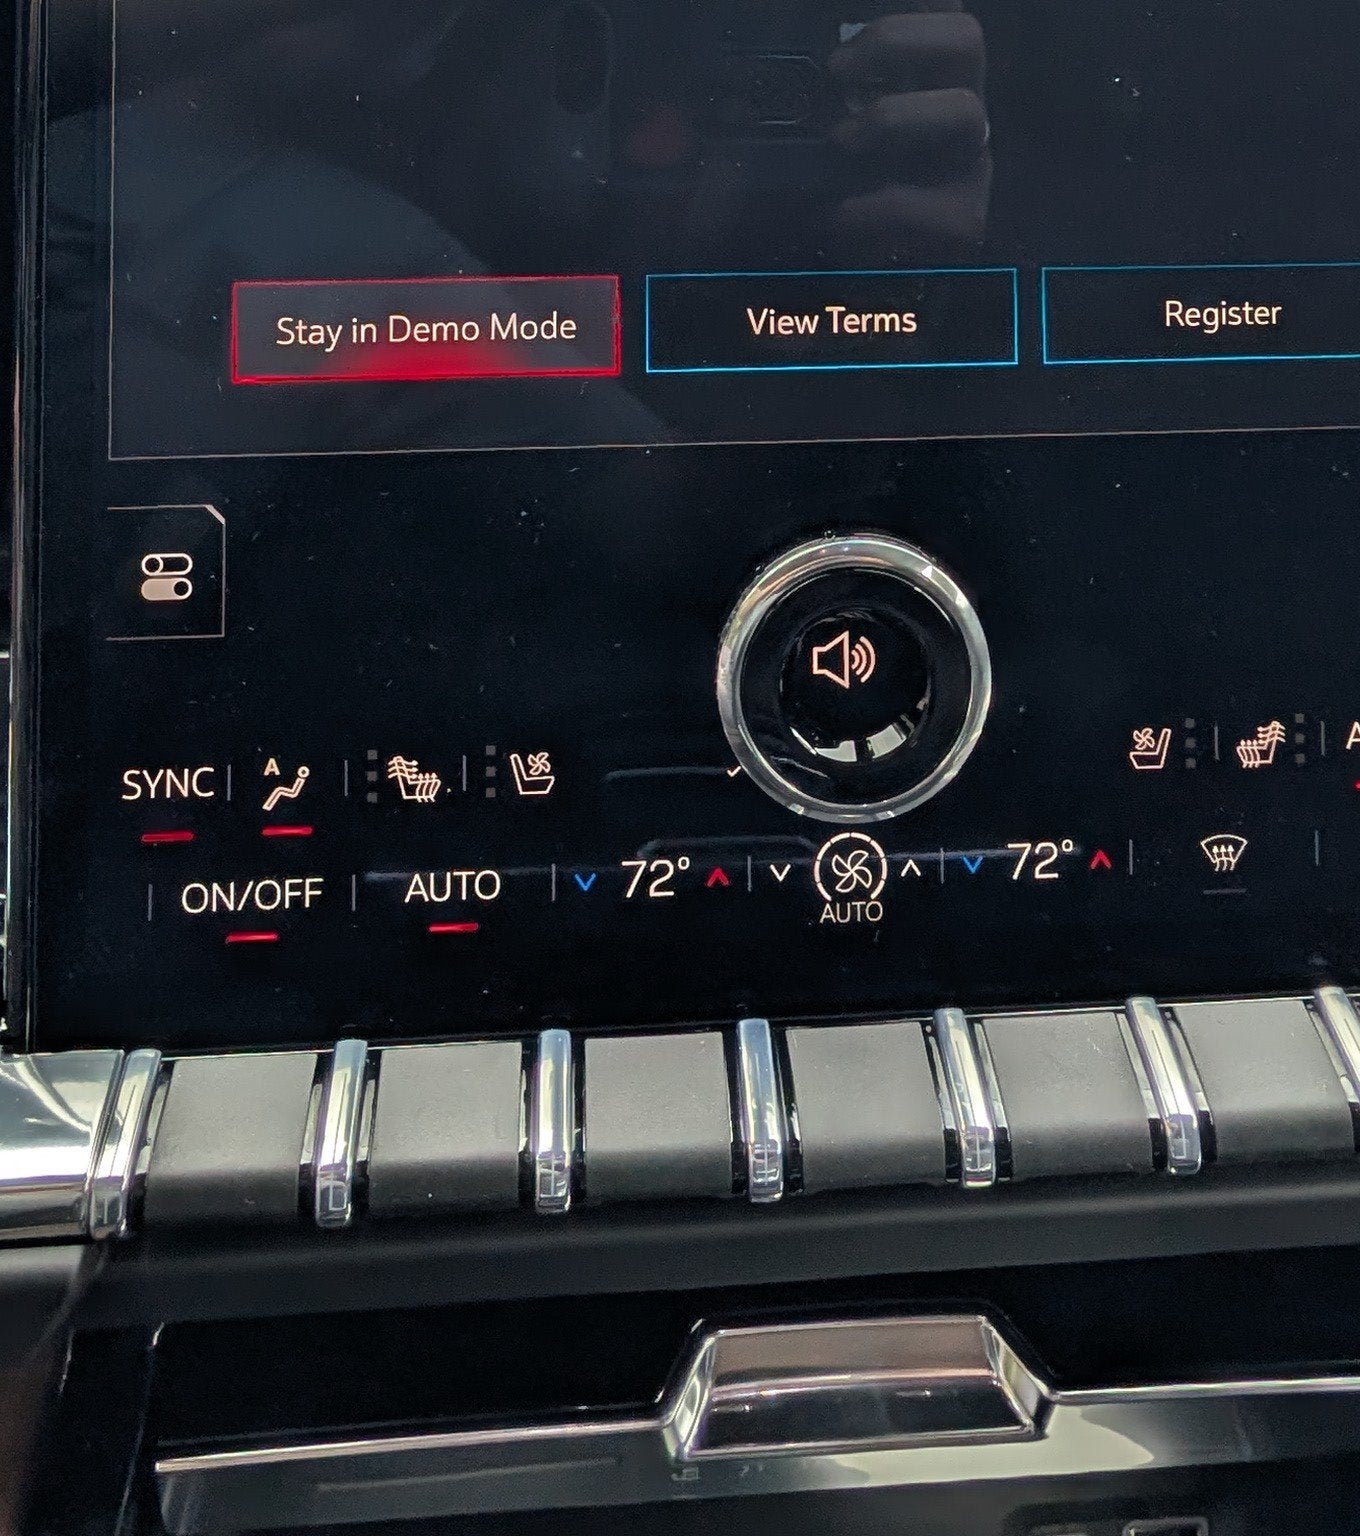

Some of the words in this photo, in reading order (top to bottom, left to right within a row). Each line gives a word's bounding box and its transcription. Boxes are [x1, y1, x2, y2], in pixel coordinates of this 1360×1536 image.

[276, 317, 343, 353] Stay
[352, 317, 377, 343] in
[389, 315, 480, 343] Demo
[490, 310, 577, 341] Mode
[746, 306, 818, 335] View
[824, 305, 918, 335] Terms
[1165, 300, 1283, 334] Register
[121, 766, 215, 801] SYNC
[181, 877, 324, 914] ON/OFF
[404, 869, 501, 903] AUTO
[819, 900, 884, 925] AUTO
